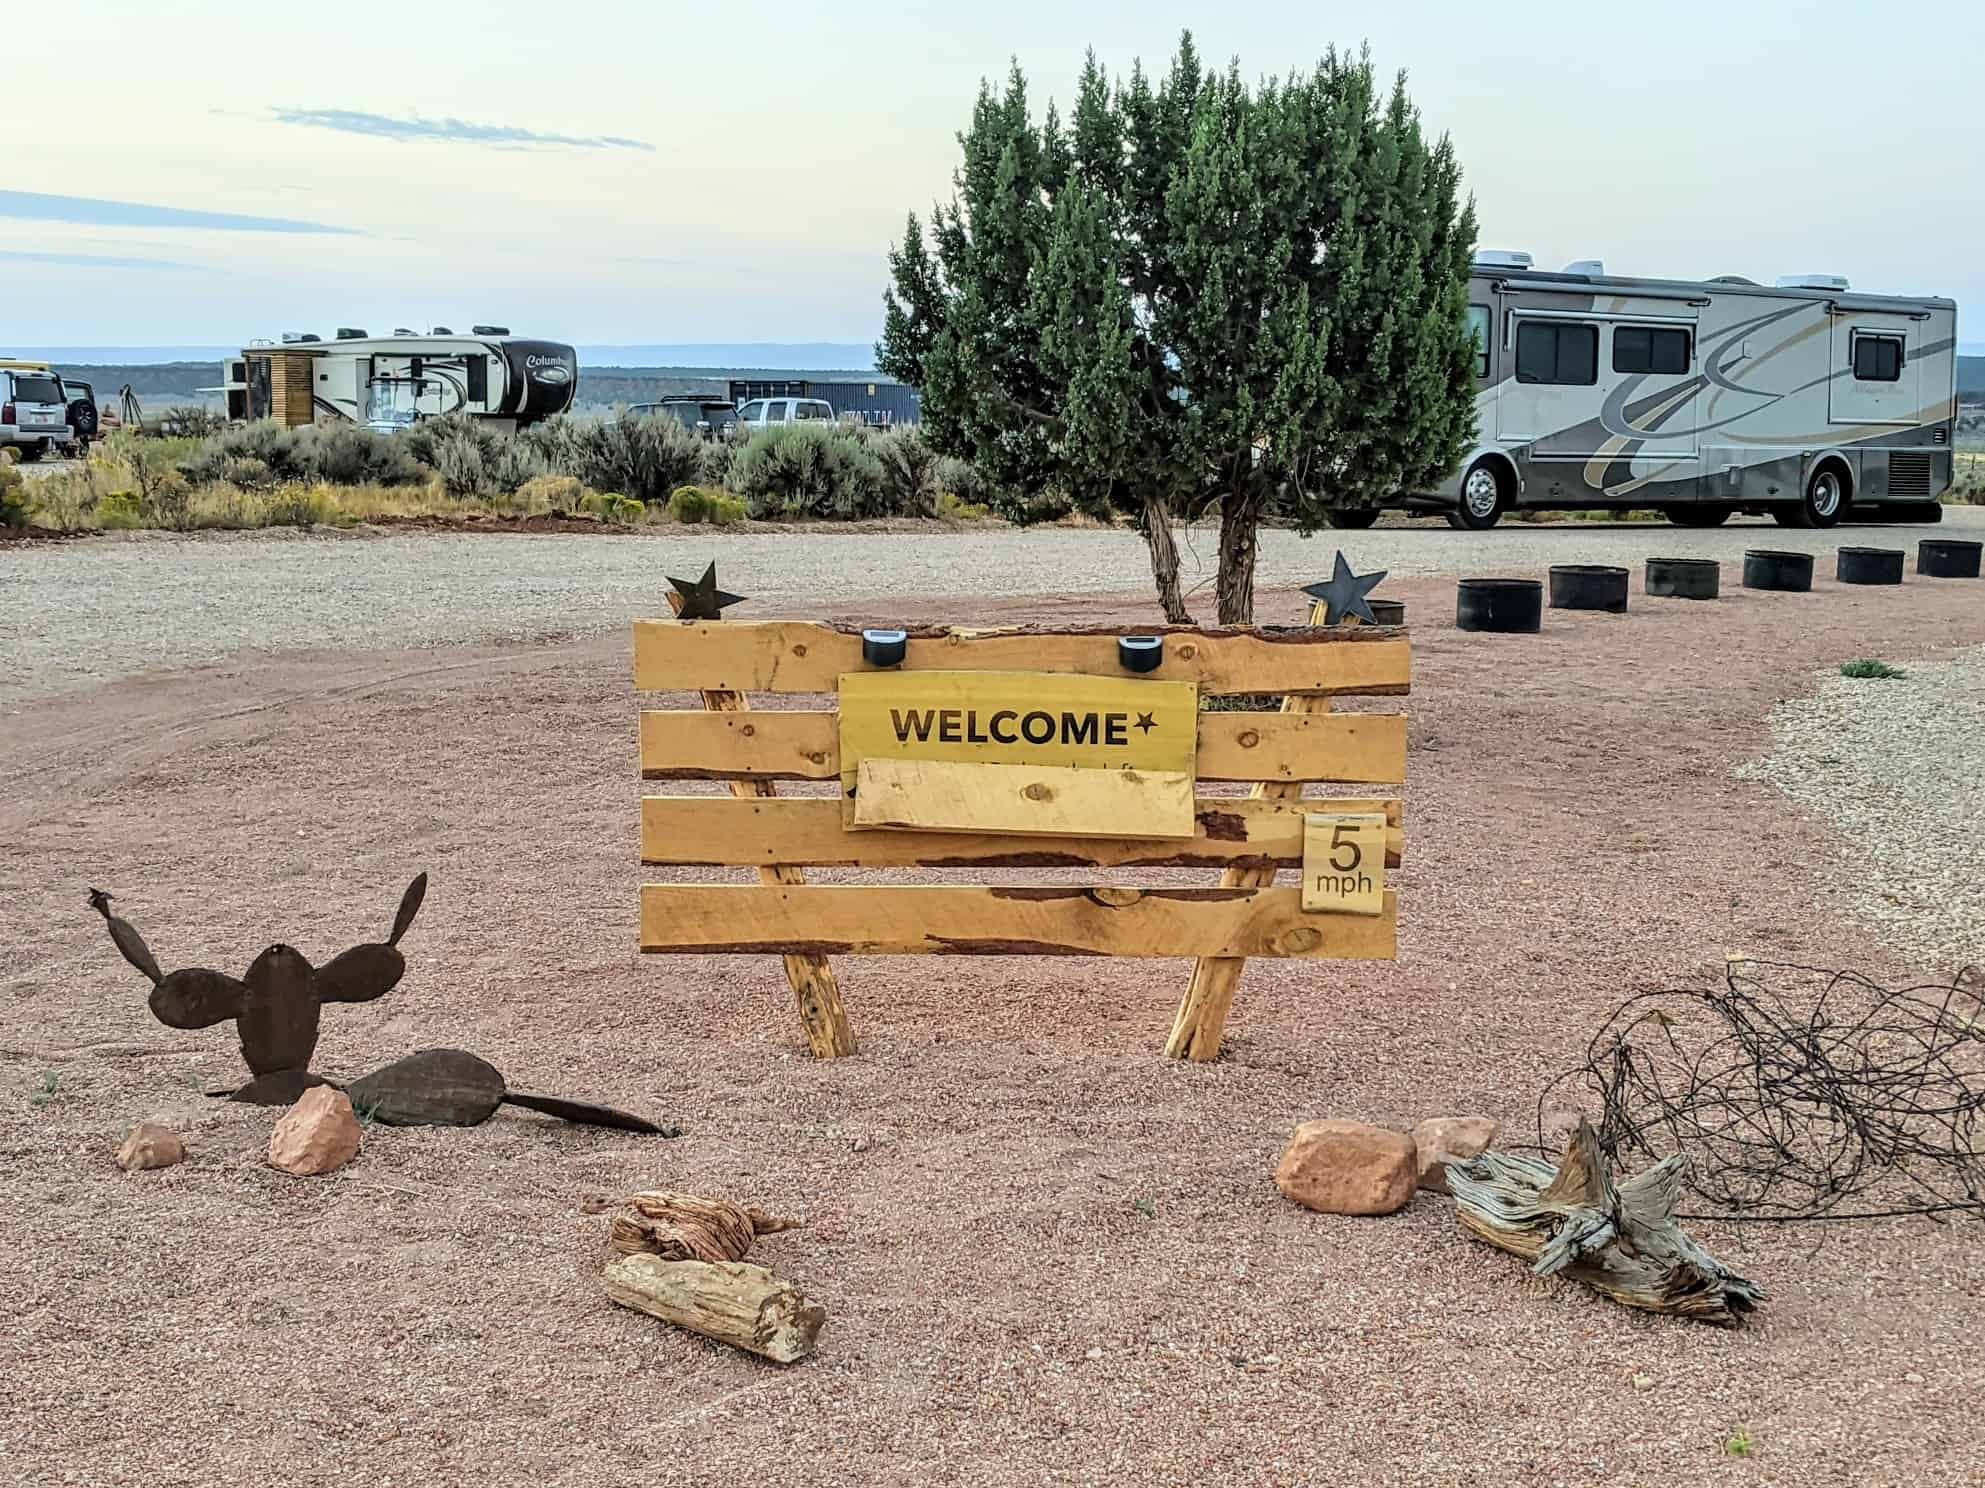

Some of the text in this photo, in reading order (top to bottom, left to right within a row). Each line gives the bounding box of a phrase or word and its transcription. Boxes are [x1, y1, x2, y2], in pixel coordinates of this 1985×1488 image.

[889, 709, 1129, 746] WELCOME
[1329, 825, 1362, 872] 5
[1316, 871, 1372, 898] mph
